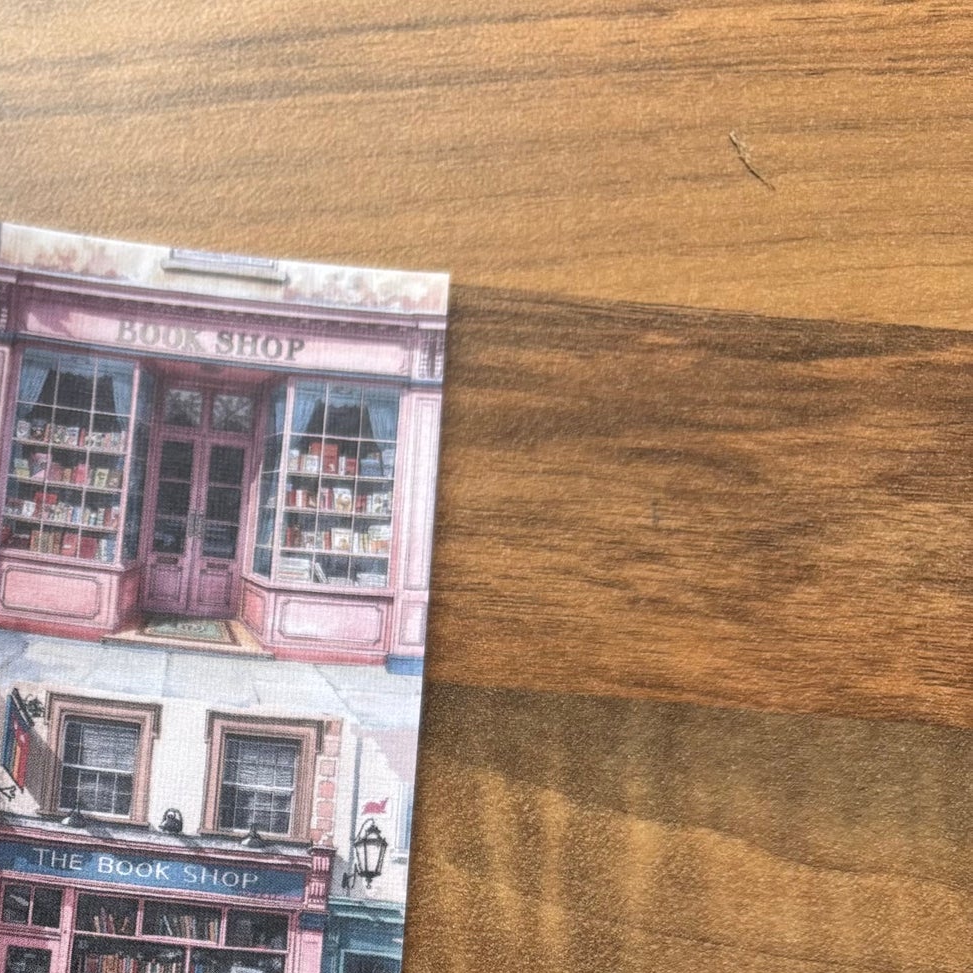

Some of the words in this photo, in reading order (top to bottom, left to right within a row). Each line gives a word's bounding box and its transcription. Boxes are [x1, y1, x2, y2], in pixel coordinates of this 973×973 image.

[115, 319, 203, 352] BOOK
[214, 330, 306, 361] SHOP
[32, 847, 83, 871] THE
[97, 855, 170, 881] BOOK
[183, 865, 259, 889] SHOP
